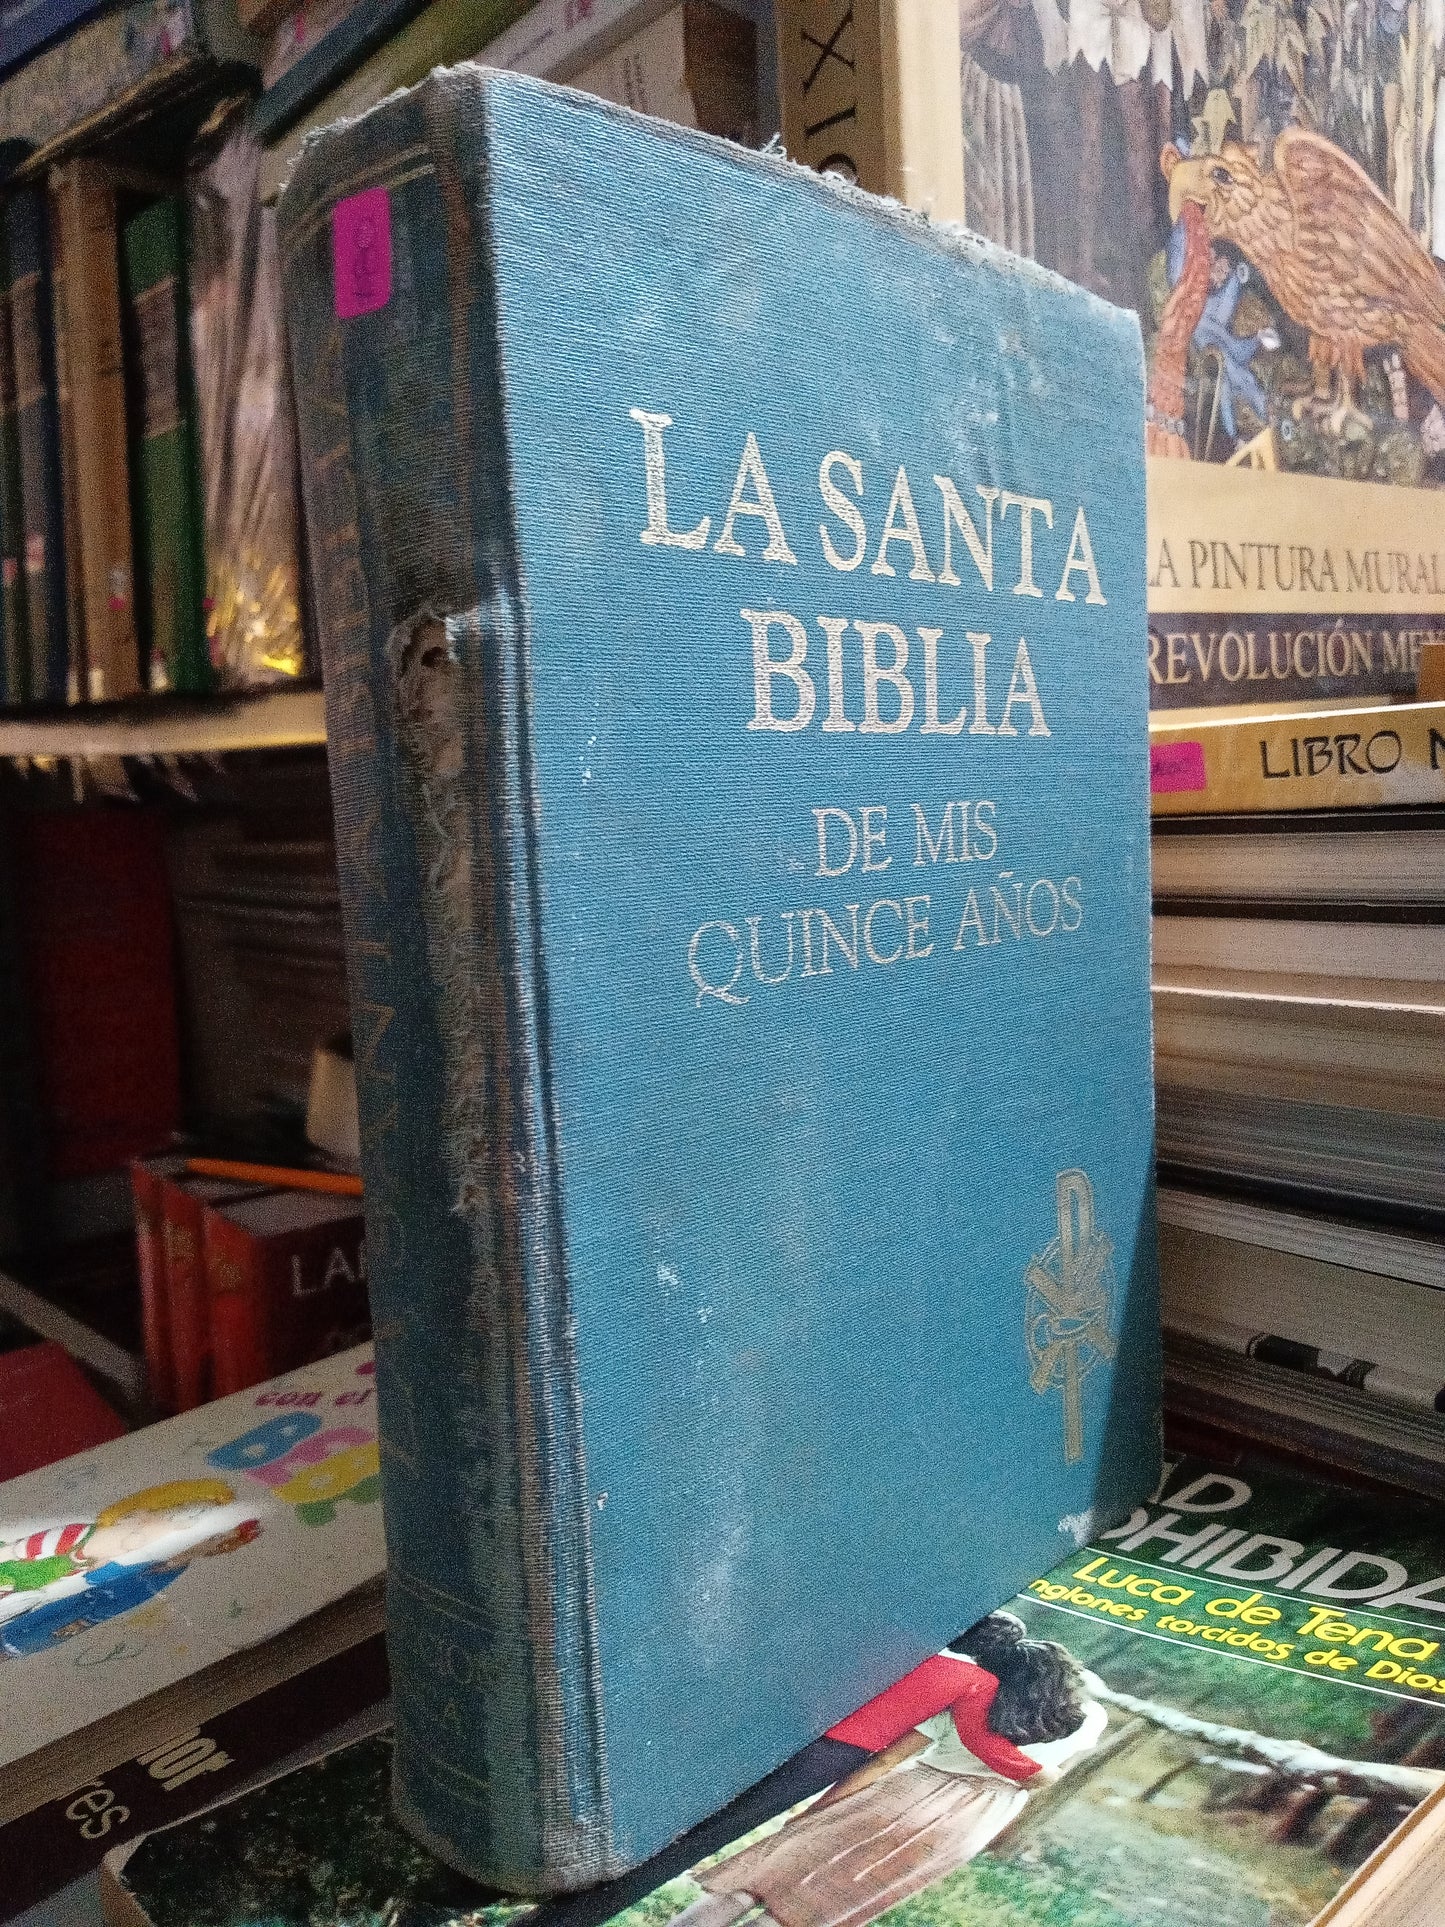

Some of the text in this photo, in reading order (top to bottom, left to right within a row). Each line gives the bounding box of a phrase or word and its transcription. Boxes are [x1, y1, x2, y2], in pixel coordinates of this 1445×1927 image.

[630, 408, 1107, 606] LA SANTA
[1188, 540, 1339, 592] PINTURA
[1346, 550, 1445, 594] MURAL
[740, 608, 1051, 738] BIBLIA
[1259, 730, 1402, 779] LIBRO
[812, 800, 998, 876] DE MIS
[687, 871, 1083, 1008] QUINCE AÑOS
[1029, 1579, 1445, 1693] nglones torcidos de Dios
[1072, 1557, 1440, 1661] Luca de Tena
